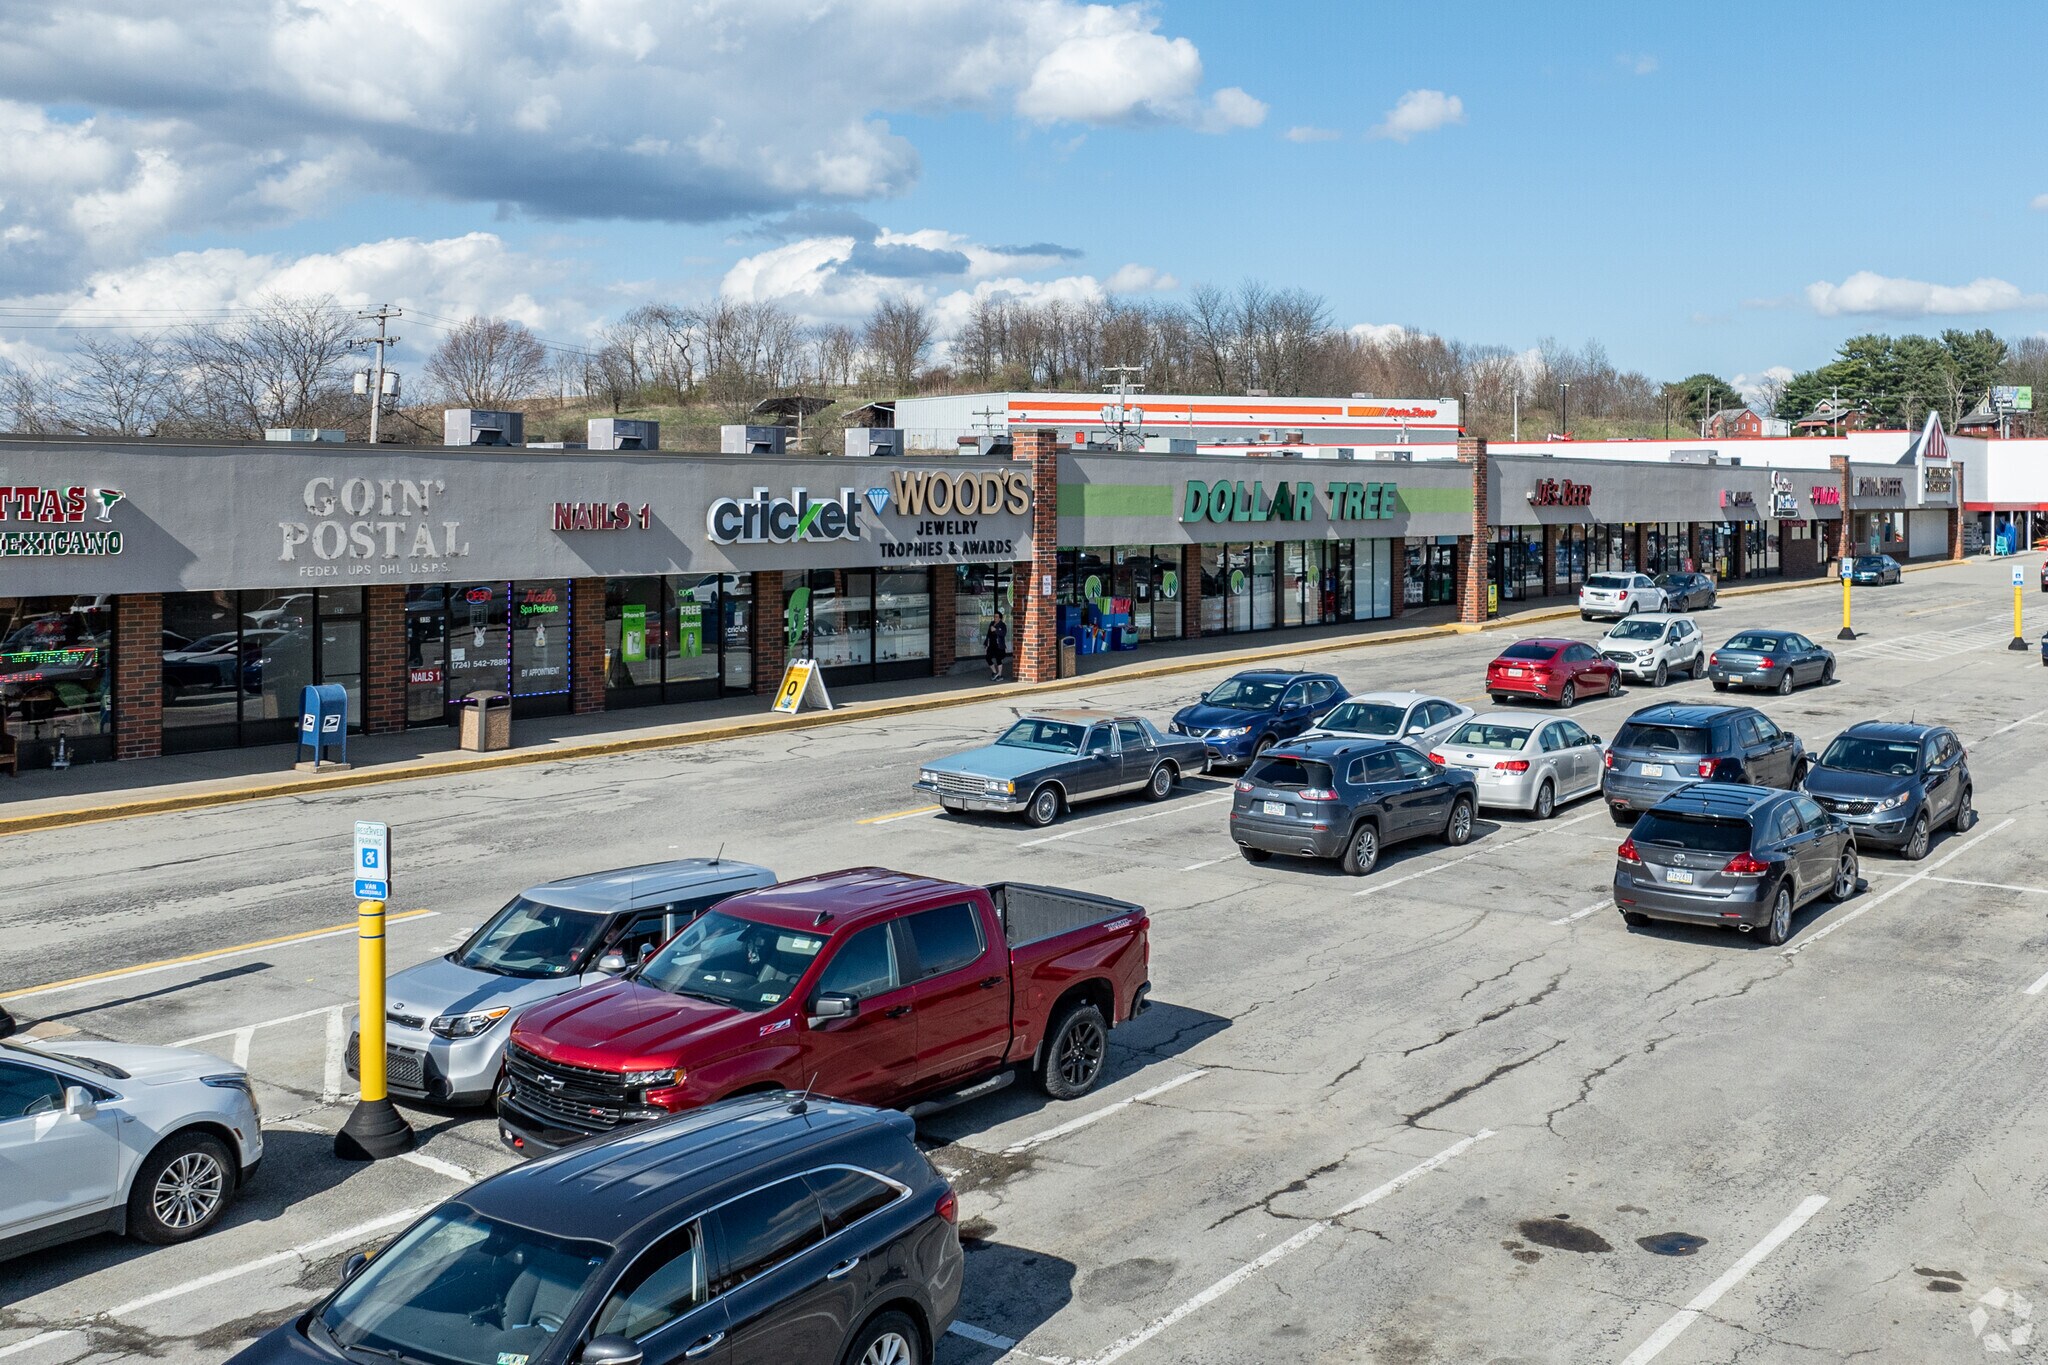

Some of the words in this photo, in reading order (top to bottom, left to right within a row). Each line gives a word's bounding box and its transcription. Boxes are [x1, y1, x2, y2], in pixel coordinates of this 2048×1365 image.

[1385, 407, 1437, 418] AutoZone
[304, 477, 446, 516] GOIN'
[891, 468, 1030, 516] WOOD'S
[1182, 480, 1314, 521] DOLLAR
[1327, 482, 1396, 518] TREE
[550, 502, 632, 530] NAILS
[637, 502, 651, 529] 1
[707, 485, 863, 543] cricket
[917, 520, 978, 535] JEWELRY
[0, 531, 123, 557] EXICANO
[278, 520, 470, 561] POSTAL
[880, 543, 943, 559] TROPHIES
[949, 541, 958, 556] &
[962, 540, 1012, 556] AWARDS
[300, 565, 339, 577] FEDEX
[348, 564, 371, 575] UPS
[380, 563, 402, 574] DHL
[410, 560, 452, 574] U.S.P.S.
[523, 589, 557, 603] Nails
[520, 604, 532, 615] Spa
[533, 604, 559, 612] Pedicure
[680, 606, 701, 616] FREE
[981, 605, 1005, 617] Vale
[680, 622, 701, 630] phones
[473, 659, 508, 668] 542-7889
[411, 672, 434, 682] NAILS
[436, 671, 440, 680] 1
[521, 671, 528, 680] BY
[529, 667, 560, 679] APPOINTMENT
[365, 883, 377, 891] VAN
